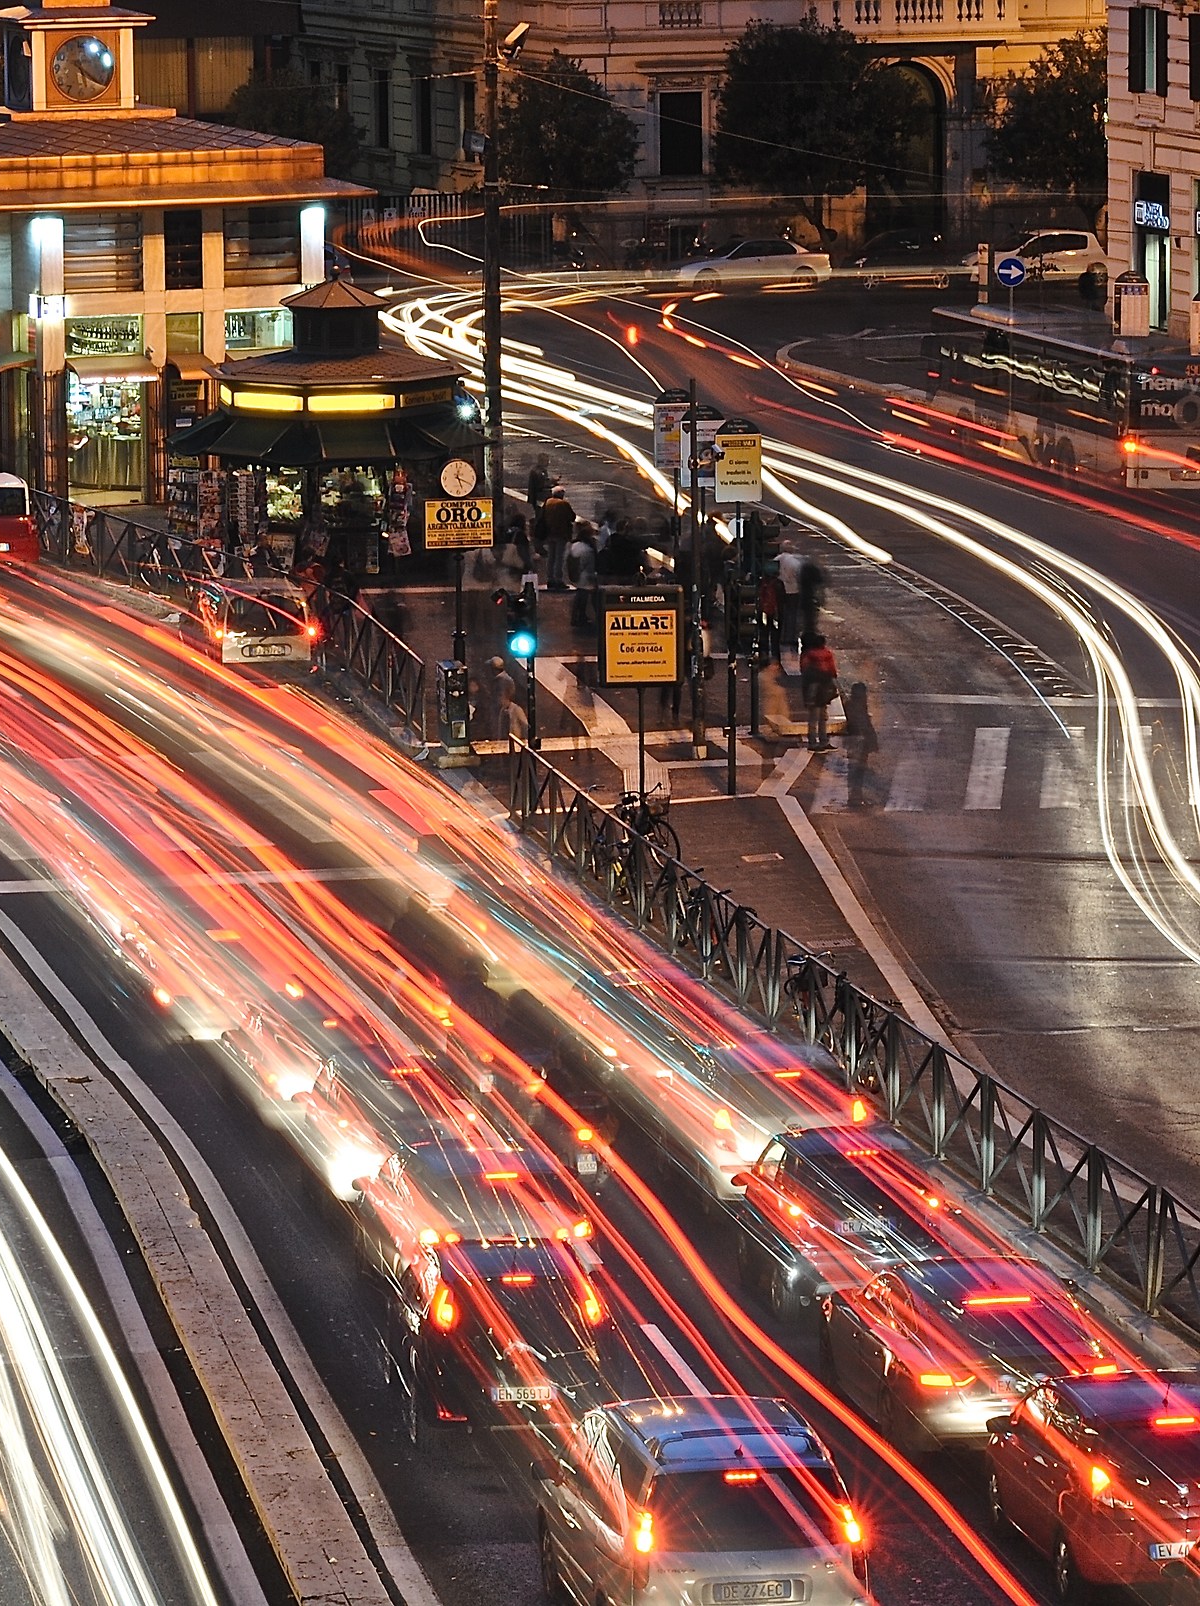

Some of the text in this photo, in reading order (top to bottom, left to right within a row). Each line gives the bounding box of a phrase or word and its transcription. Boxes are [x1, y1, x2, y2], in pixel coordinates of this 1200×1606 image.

[436, 507, 482, 523] ORO
[610, 616, 668, 630] ALLART
[1158, 1545, 1172, 1557] EV
[723, 1584, 783, 1598] DE 274EC
